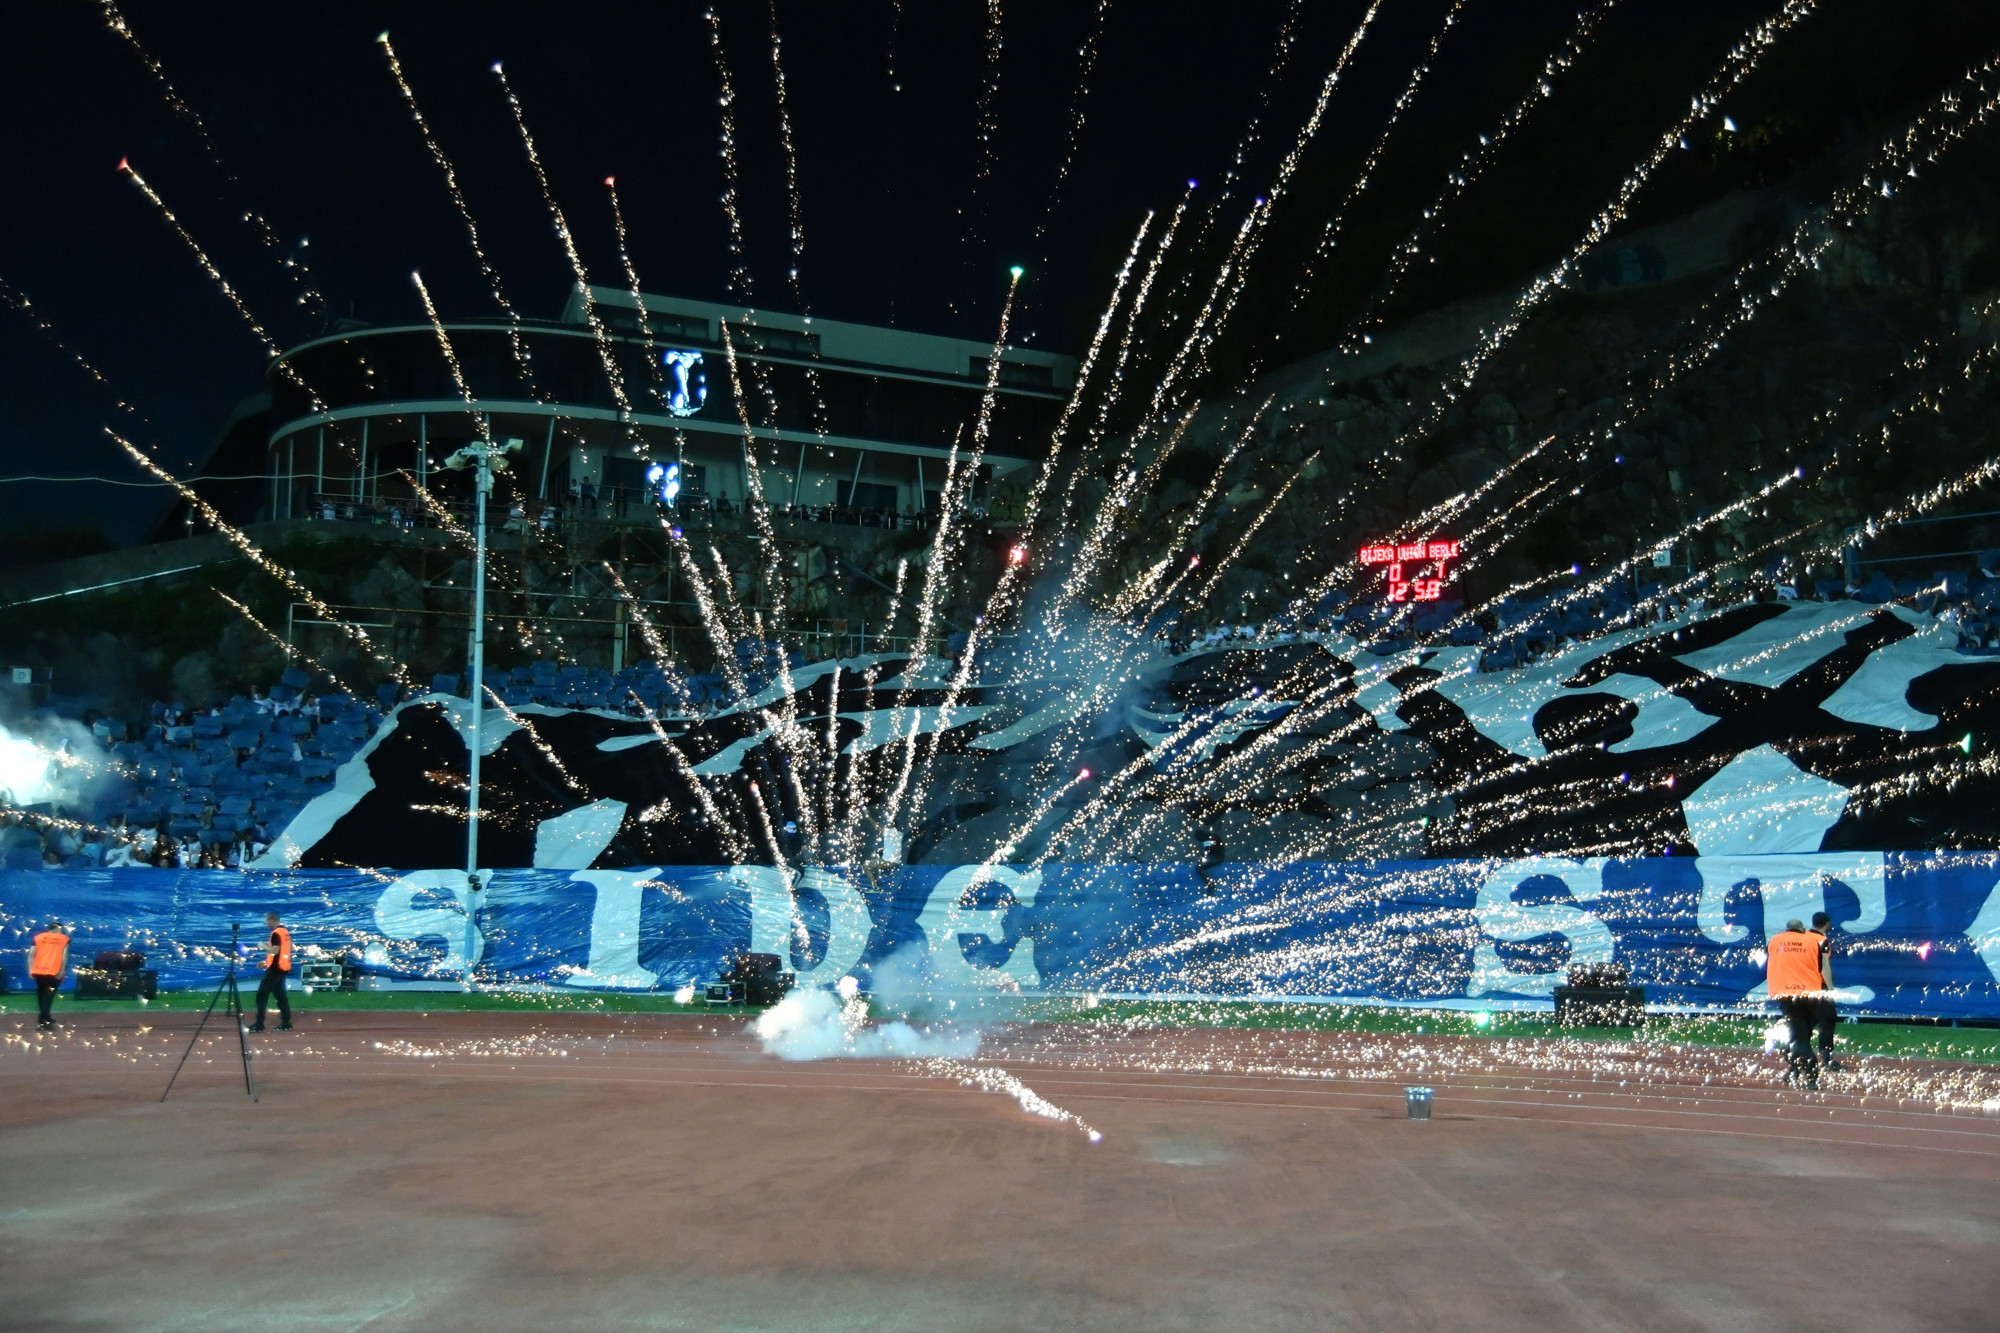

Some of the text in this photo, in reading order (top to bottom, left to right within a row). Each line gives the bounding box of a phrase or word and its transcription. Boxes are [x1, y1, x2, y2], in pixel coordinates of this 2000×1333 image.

[1360, 547, 1394, 563] RIJEKA
[1397, 545, 1426, 560] UNION
[364, 864, 1044, 989] SIDE
